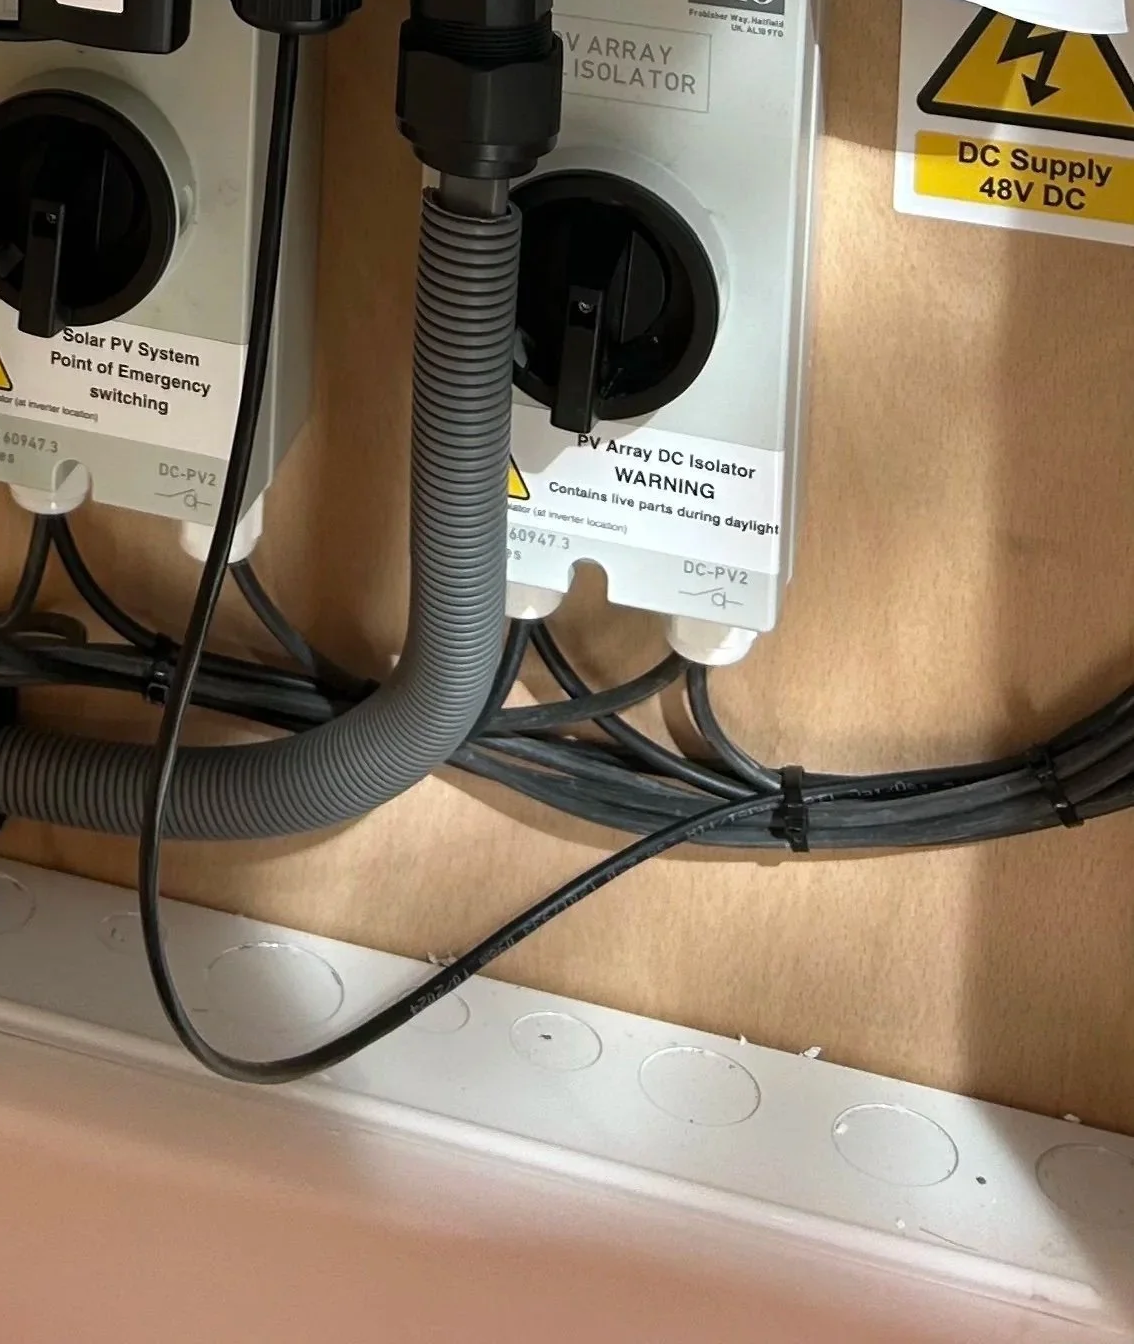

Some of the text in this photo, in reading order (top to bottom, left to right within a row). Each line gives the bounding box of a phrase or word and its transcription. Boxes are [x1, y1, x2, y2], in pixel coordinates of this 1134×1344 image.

[587, 35, 673, 65] ARRAY
[574, 58, 696, 94] ISOLATOR
[958, 141, 1113, 187] DC Supply
[979, 176, 1087, 211] 48V DC
[62, 327, 200, 367] Solar PV System
[50, 350, 212, 398] Point of Emergency
[89, 385, 169, 416] switching
[577, 433, 757, 480] PV Array DC Isolator
[157, 462, 217, 487] DC-PV2
[614, 466, 716, 500] WARNING
[549, 481, 780, 536] Contains live parts during daylight
[683, 559, 749, 586] DC-PV2
